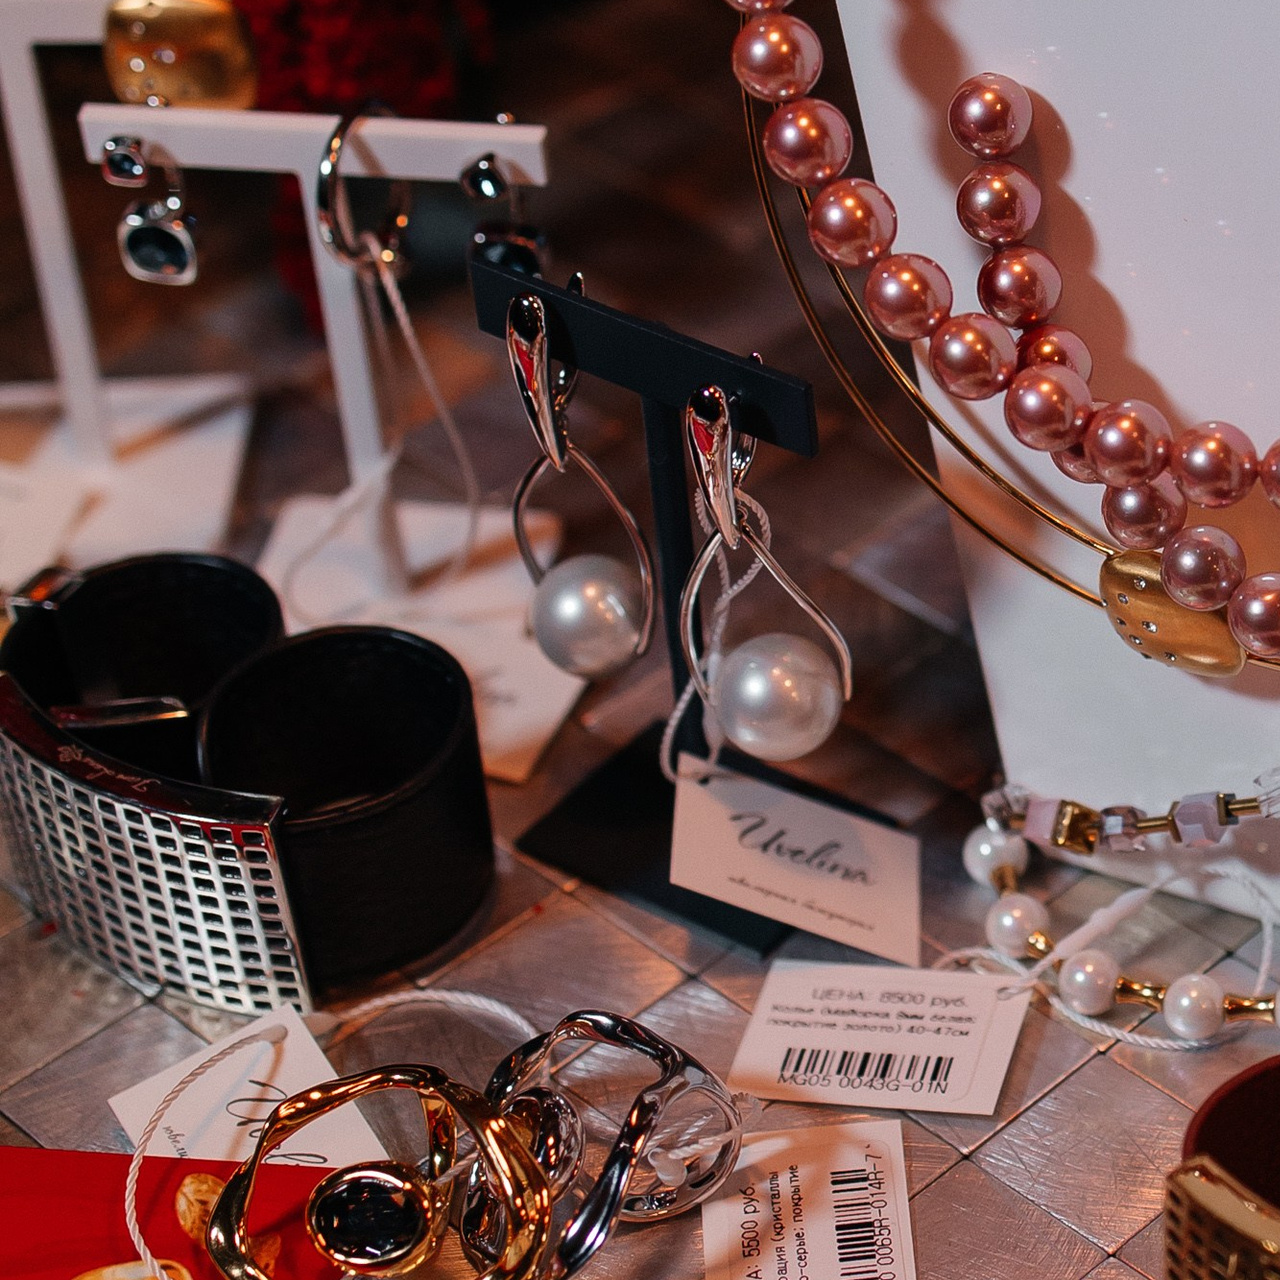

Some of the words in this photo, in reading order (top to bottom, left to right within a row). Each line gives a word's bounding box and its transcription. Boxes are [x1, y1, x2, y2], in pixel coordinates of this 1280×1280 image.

[777, 1074, 831, 1088] MG05
[839, 1075, 950, 1095] 0043G-01N
[739, 1182, 761, 1215] руб.
[769, 1171, 786, 1242] (кристаллы
[788, 1164, 804, 1223] покрытие
[741, 1220, 761, 1259] 5500
